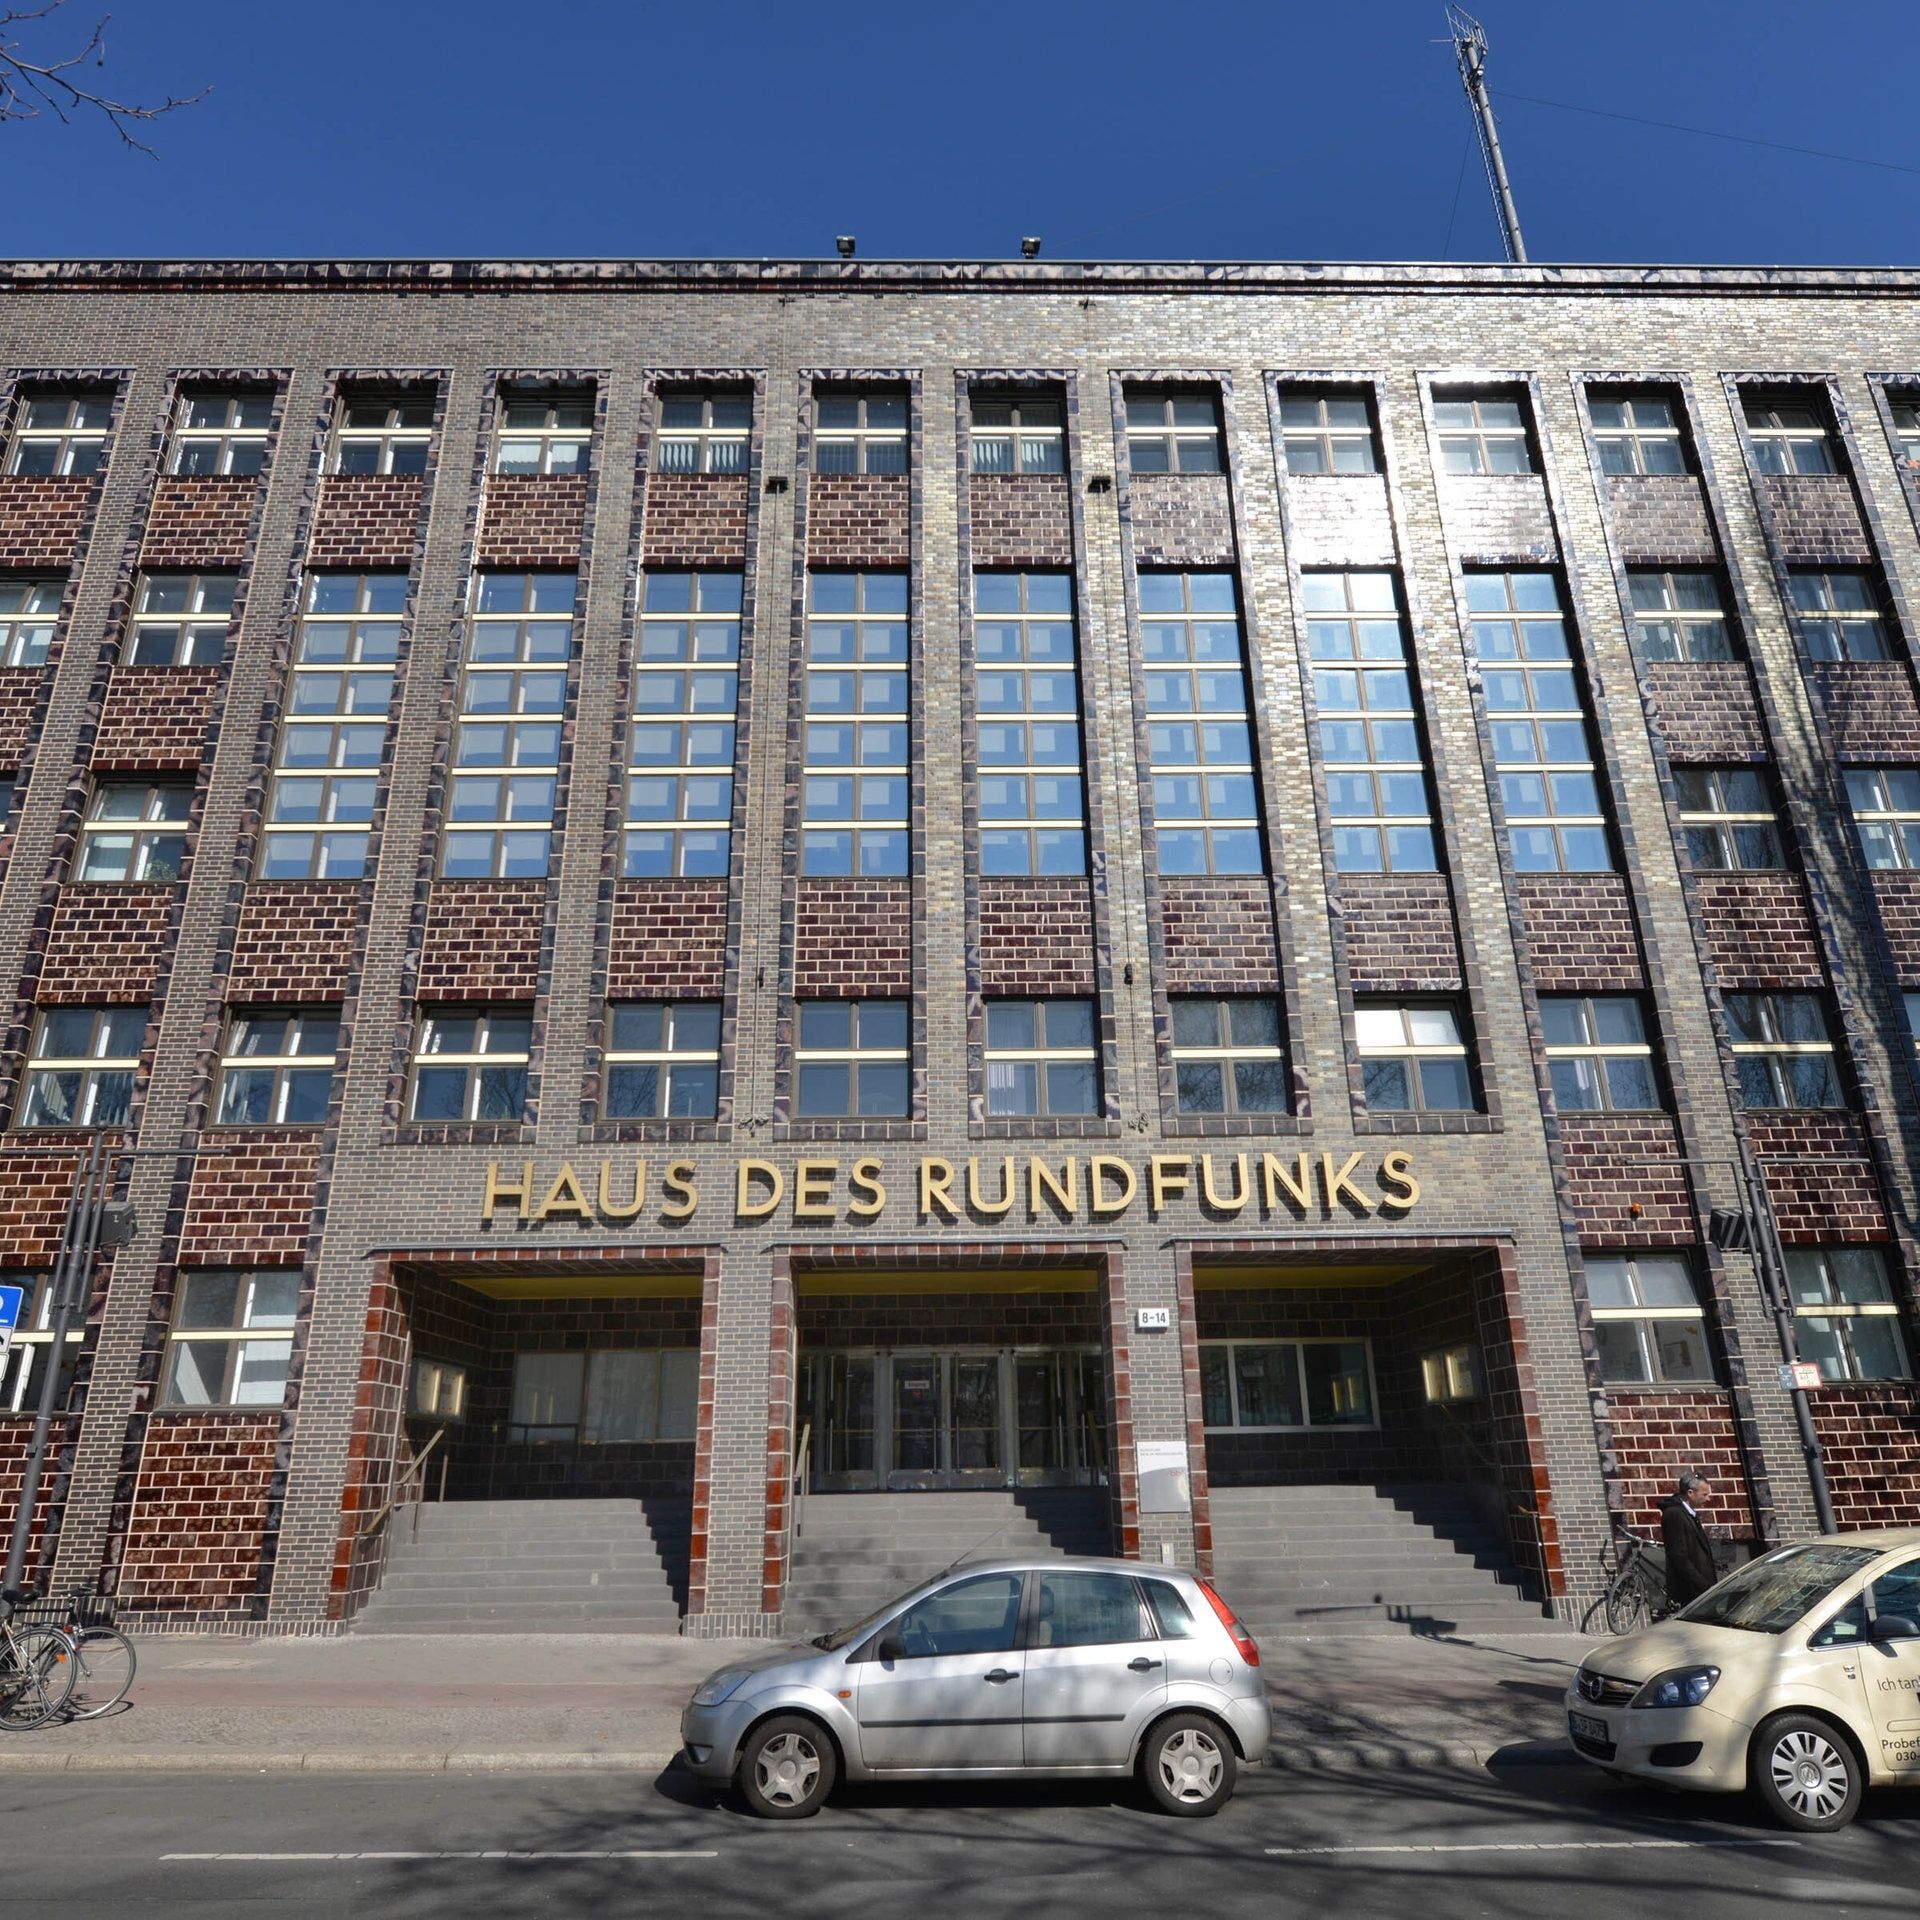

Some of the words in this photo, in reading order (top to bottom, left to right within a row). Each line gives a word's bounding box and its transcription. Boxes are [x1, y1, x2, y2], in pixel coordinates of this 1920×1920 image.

[482, 1159, 698, 1219] HAUS
[736, 1157, 887, 1217] DES
[919, 1151, 1421, 1214] RUNDFUNKS
[1142, 1312, 1166, 1324] 8-14
[1877, 1678, 1896, 1691] Ich
[1898, 1675, 1920, 1690] tan
